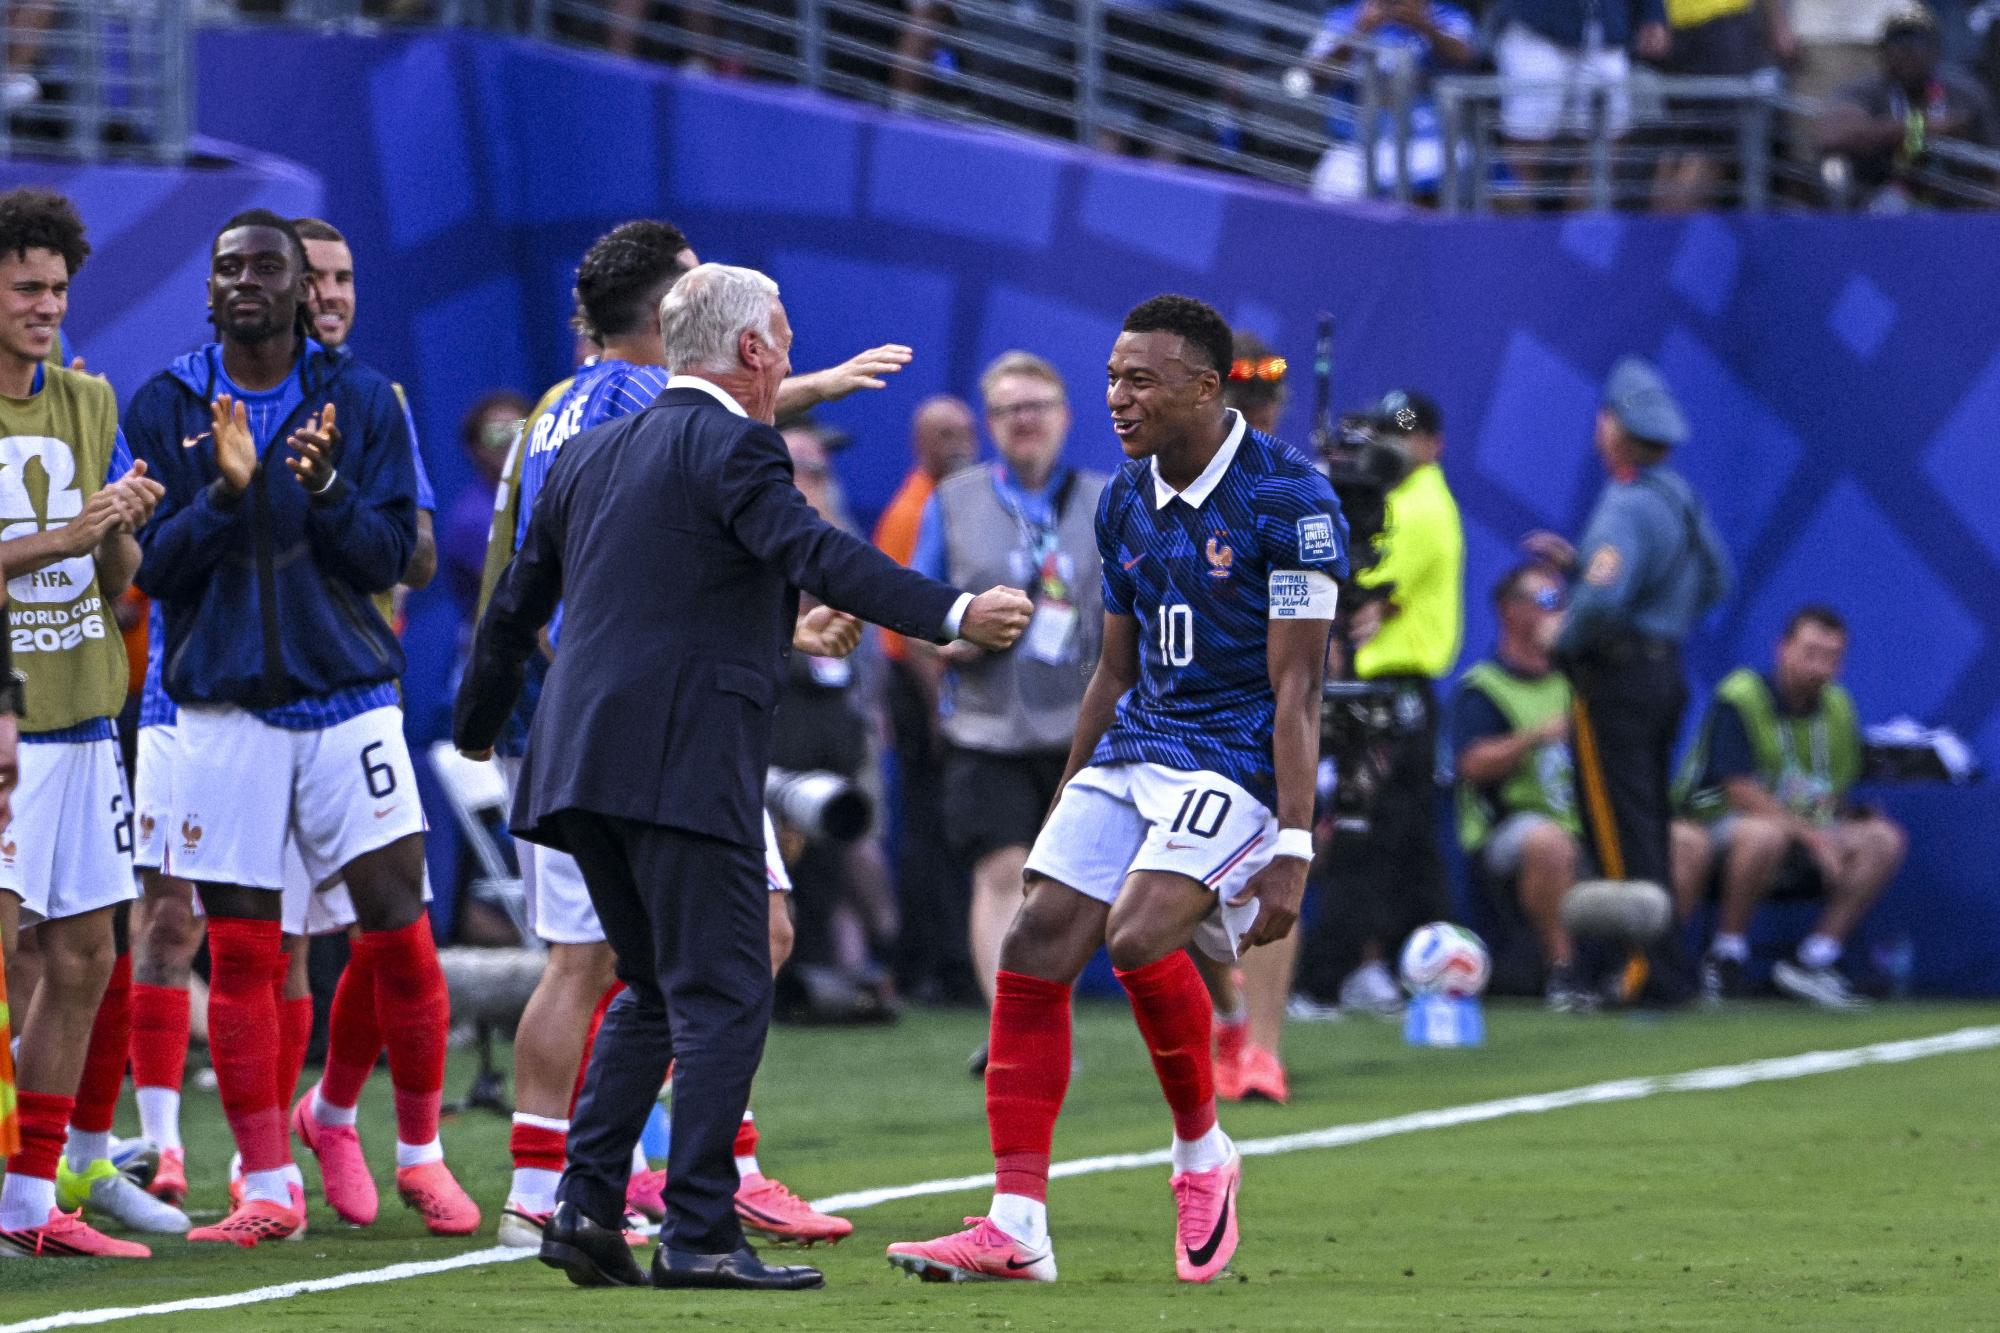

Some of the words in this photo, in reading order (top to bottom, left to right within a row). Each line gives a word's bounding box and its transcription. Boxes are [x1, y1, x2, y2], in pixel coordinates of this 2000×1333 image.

[1305, 529, 1329, 541] UNITES
[31, 570, 73, 588] FIFA
[1271, 584, 1308, 596] UNITES
[8, 609, 69, 626] WORLD
[70, 597, 102, 619] CUP
[1282, 597, 1310, 607] World
[10, 614, 105, 653] 2026
[1158, 603, 1194, 667] 10
[360, 740, 397, 799] 6
[1170, 787, 1232, 839] 10
